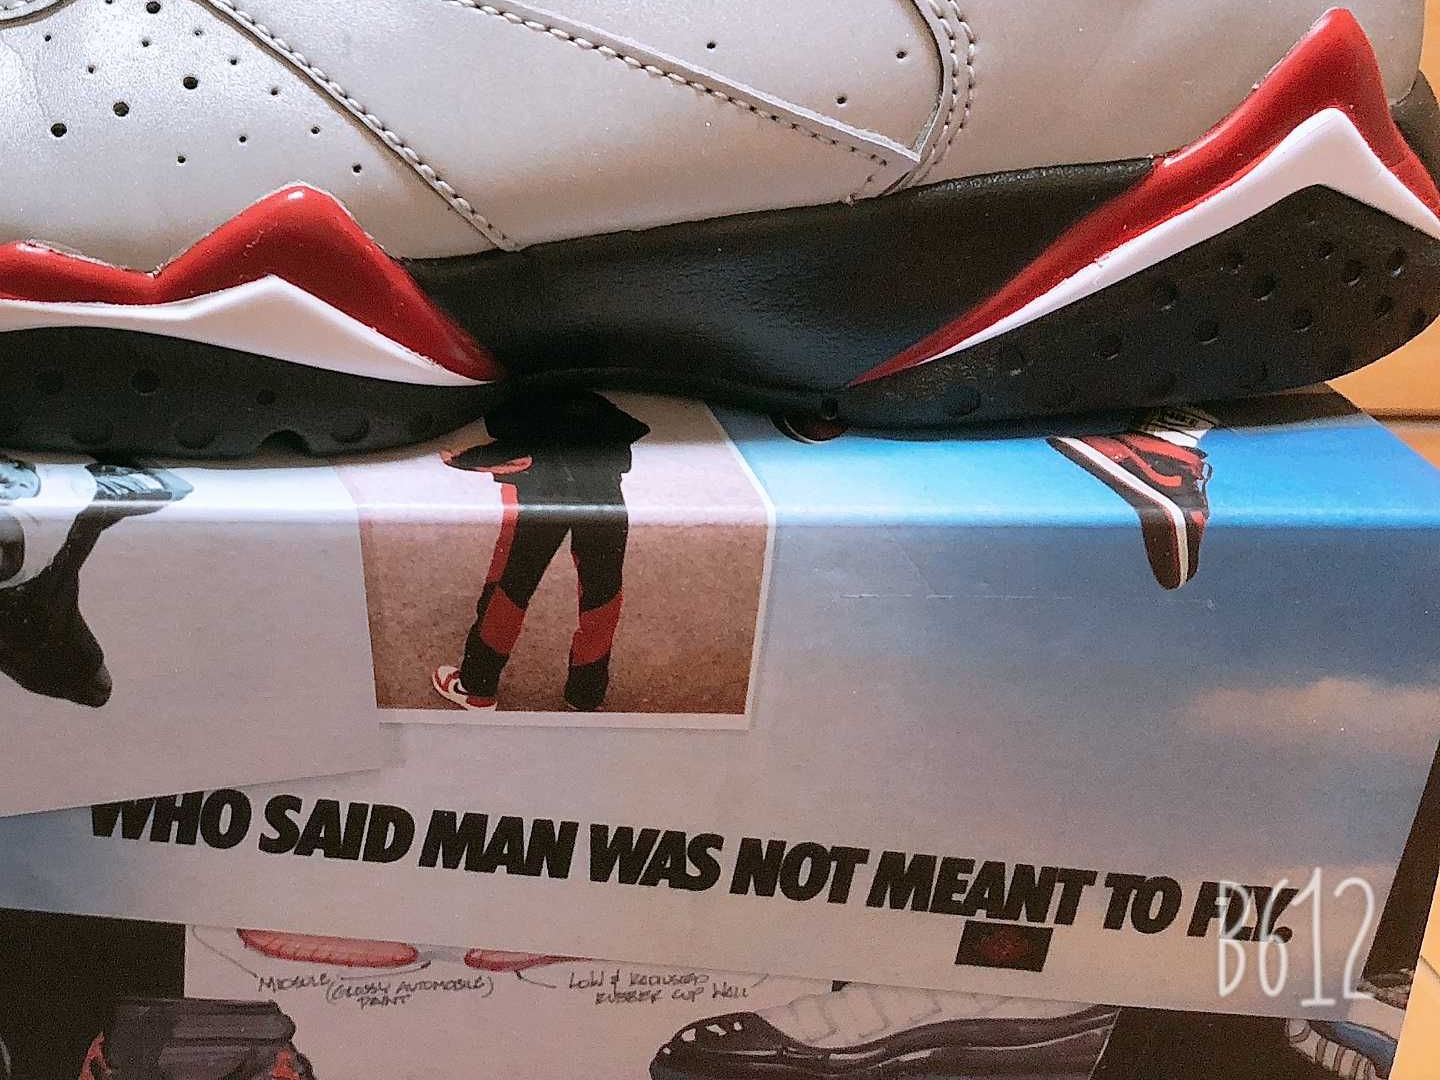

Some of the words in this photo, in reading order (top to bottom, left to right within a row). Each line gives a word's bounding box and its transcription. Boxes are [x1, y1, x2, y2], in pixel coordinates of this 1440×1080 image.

[91, 789, 252, 849] WHO
[259, 794, 415, 864] SAID
[419, 809, 578, 880] MAN
[590, 823, 724, 892] WAS
[730, 837, 869, 904] NOT
[866, 850, 1098, 926] MEANT
[1103, 871, 1182, 935] TO
